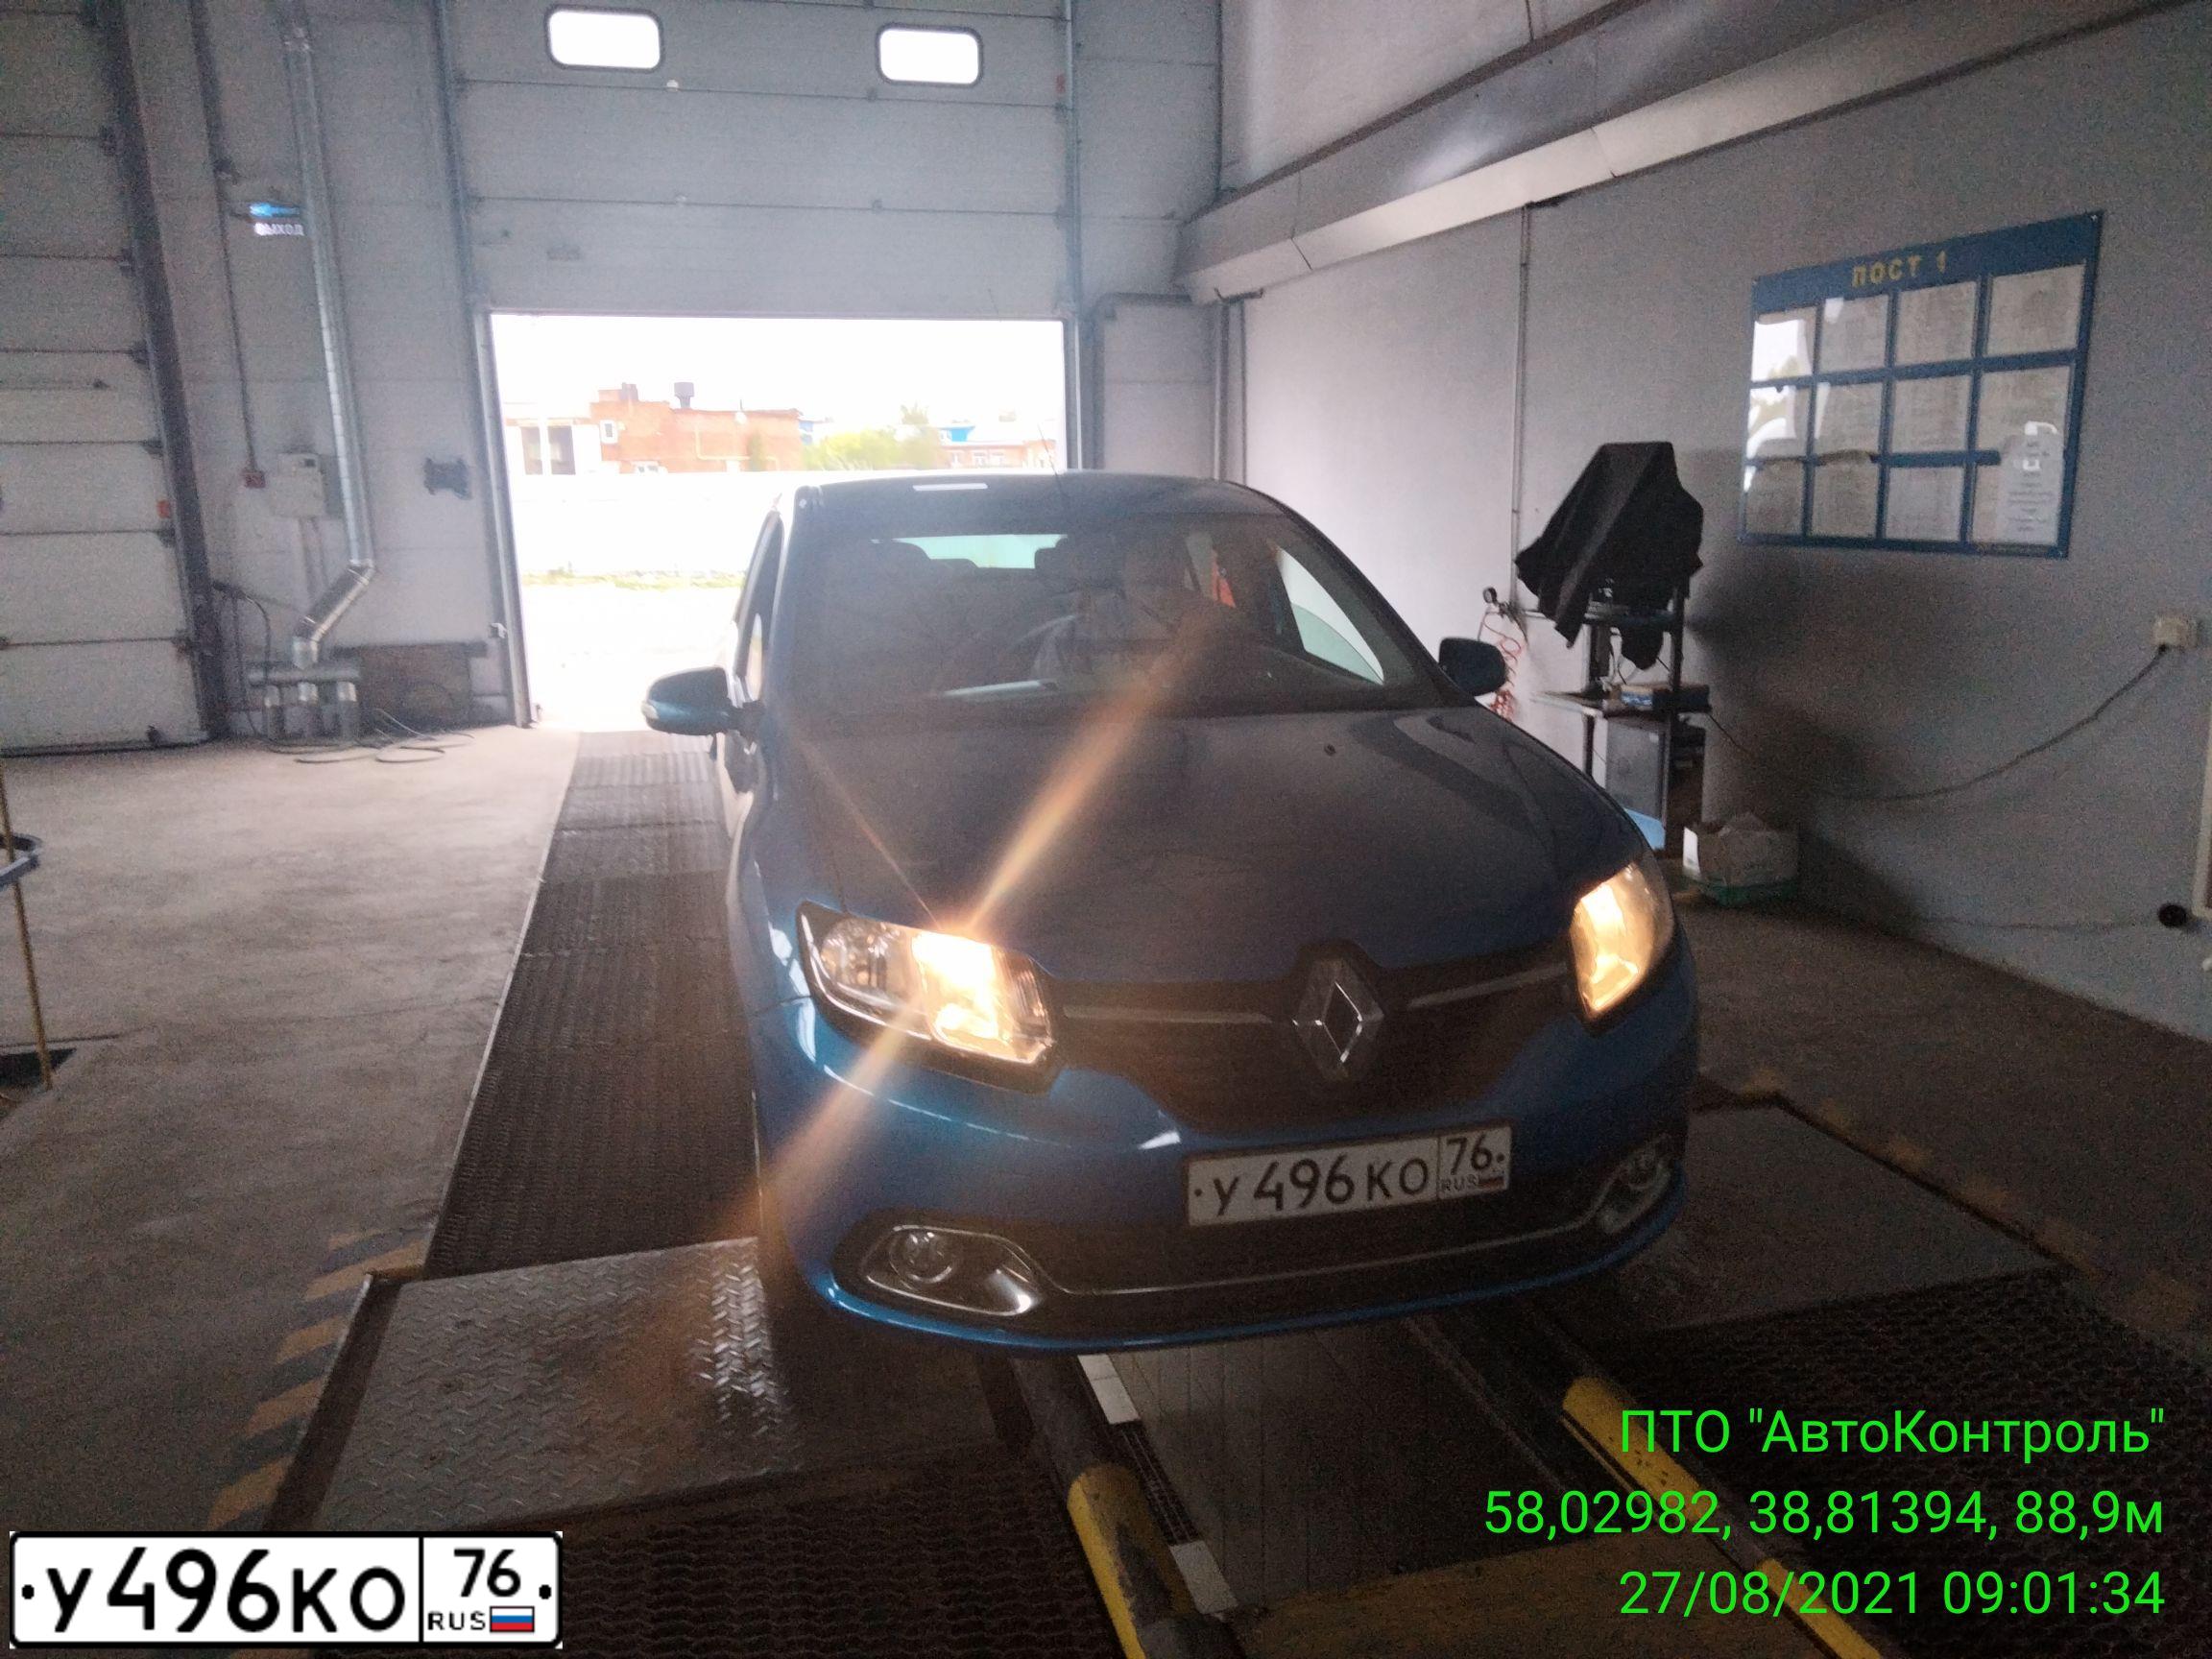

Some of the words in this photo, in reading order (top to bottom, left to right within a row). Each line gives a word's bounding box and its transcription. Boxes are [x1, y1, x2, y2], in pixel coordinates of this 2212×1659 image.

[1851, 254, 1922, 288] ПОСТ
[1936, 250, 1948, 274] 1
[1446, 1134, 1492, 1175] 76
[1441, 1173, 1479, 1192] RUS
